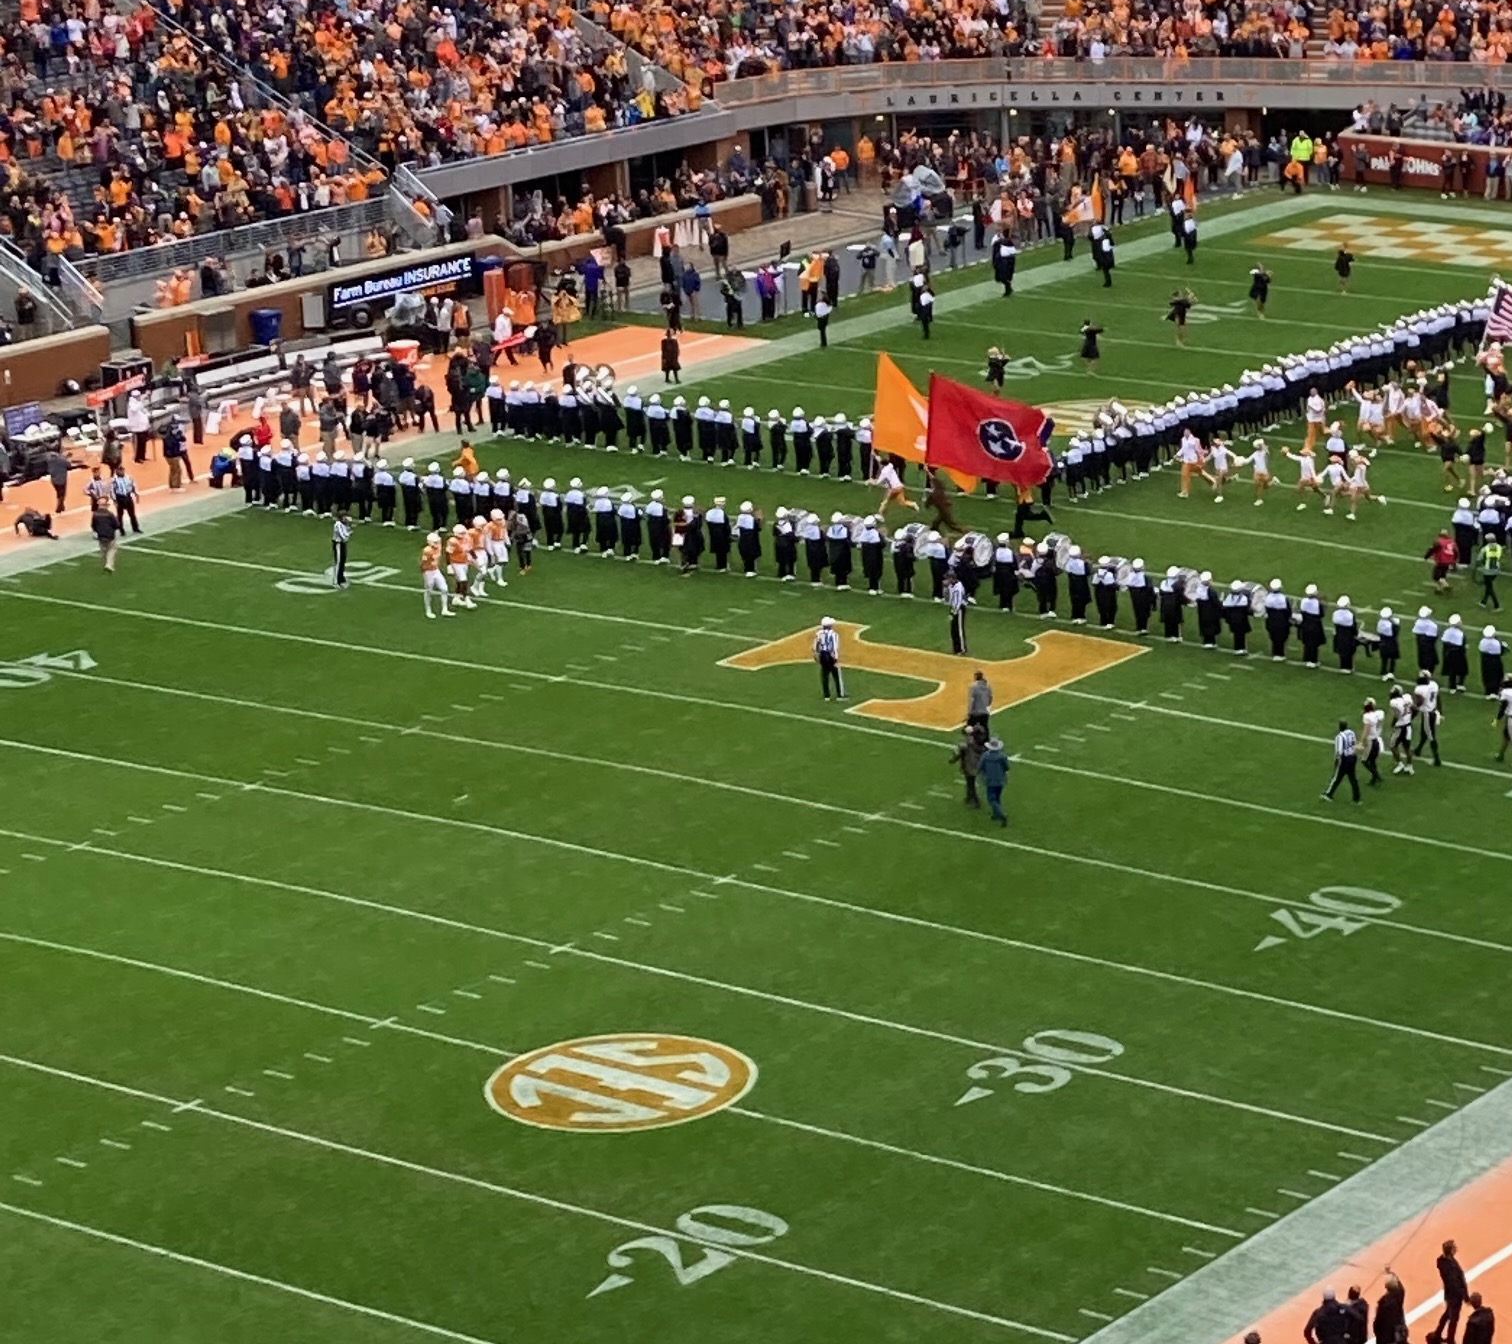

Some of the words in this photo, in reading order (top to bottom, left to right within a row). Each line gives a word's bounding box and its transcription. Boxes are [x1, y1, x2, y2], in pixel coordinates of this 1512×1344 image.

[1113, 91, 1226, 101] CENTER
[333, 285, 363, 302] Farm
[365, 276, 402, 295] Bureau
[404, 257, 471, 285] INSURANCE
[1270, 886, 1402, 938] 40
[966, 1029, 1125, 1094] 30
[607, 1204, 789, 1285] 20
